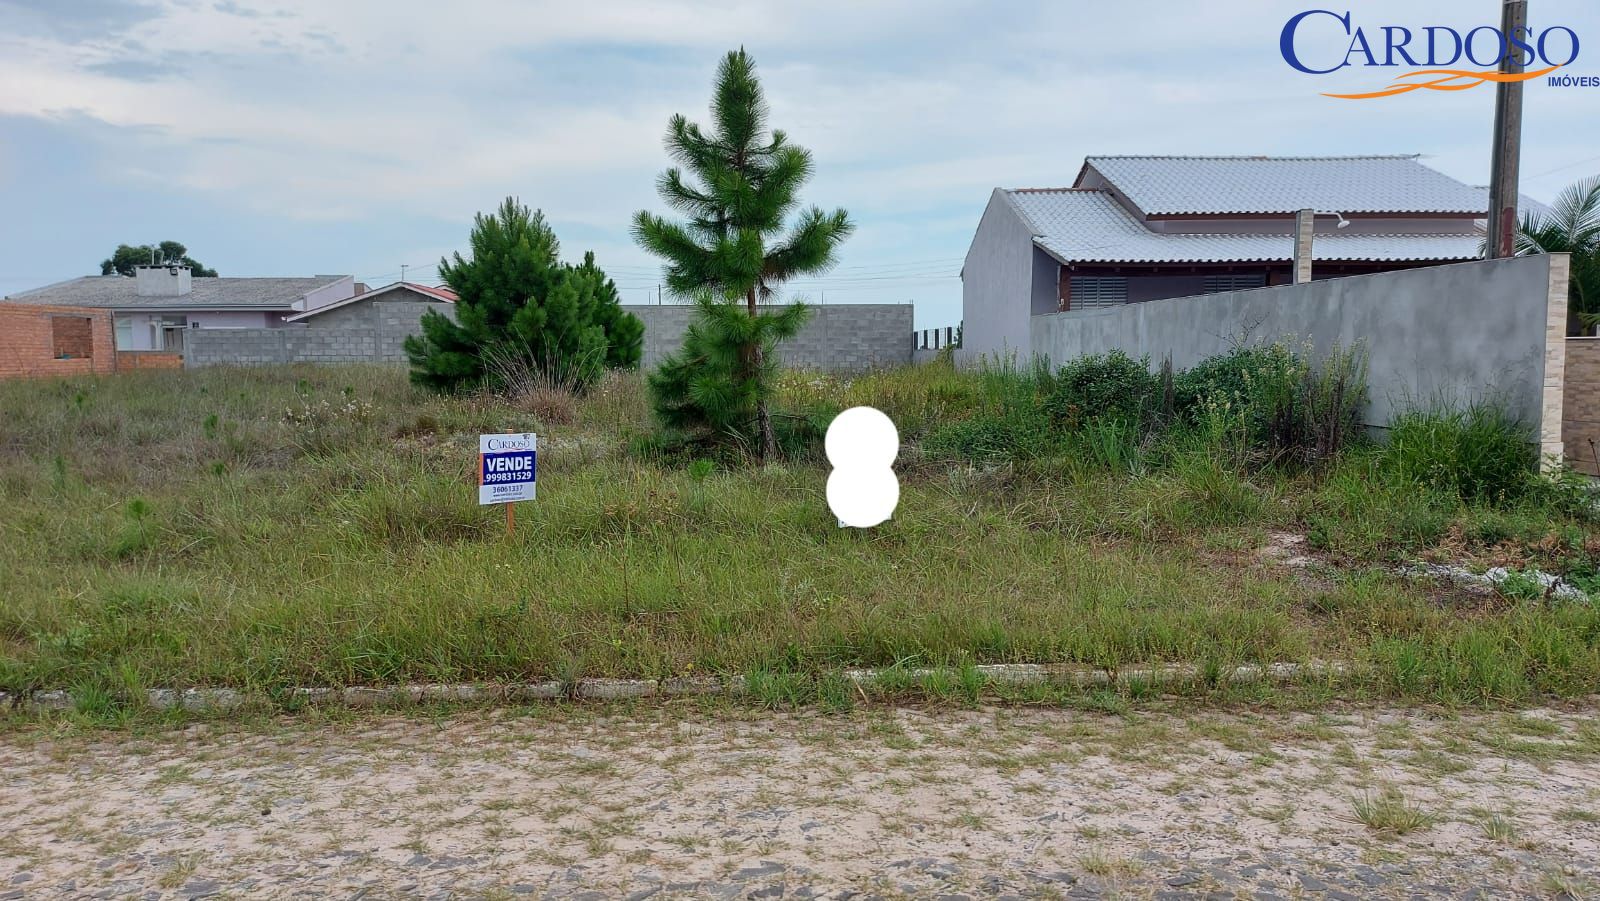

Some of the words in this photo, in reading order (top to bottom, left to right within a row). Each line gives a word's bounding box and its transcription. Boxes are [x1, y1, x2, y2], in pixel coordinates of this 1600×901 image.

[488, 438, 530, 450] CARDOSO
[486, 456, 532, 472] VENDE
[486, 471, 531, 482] 999831529
